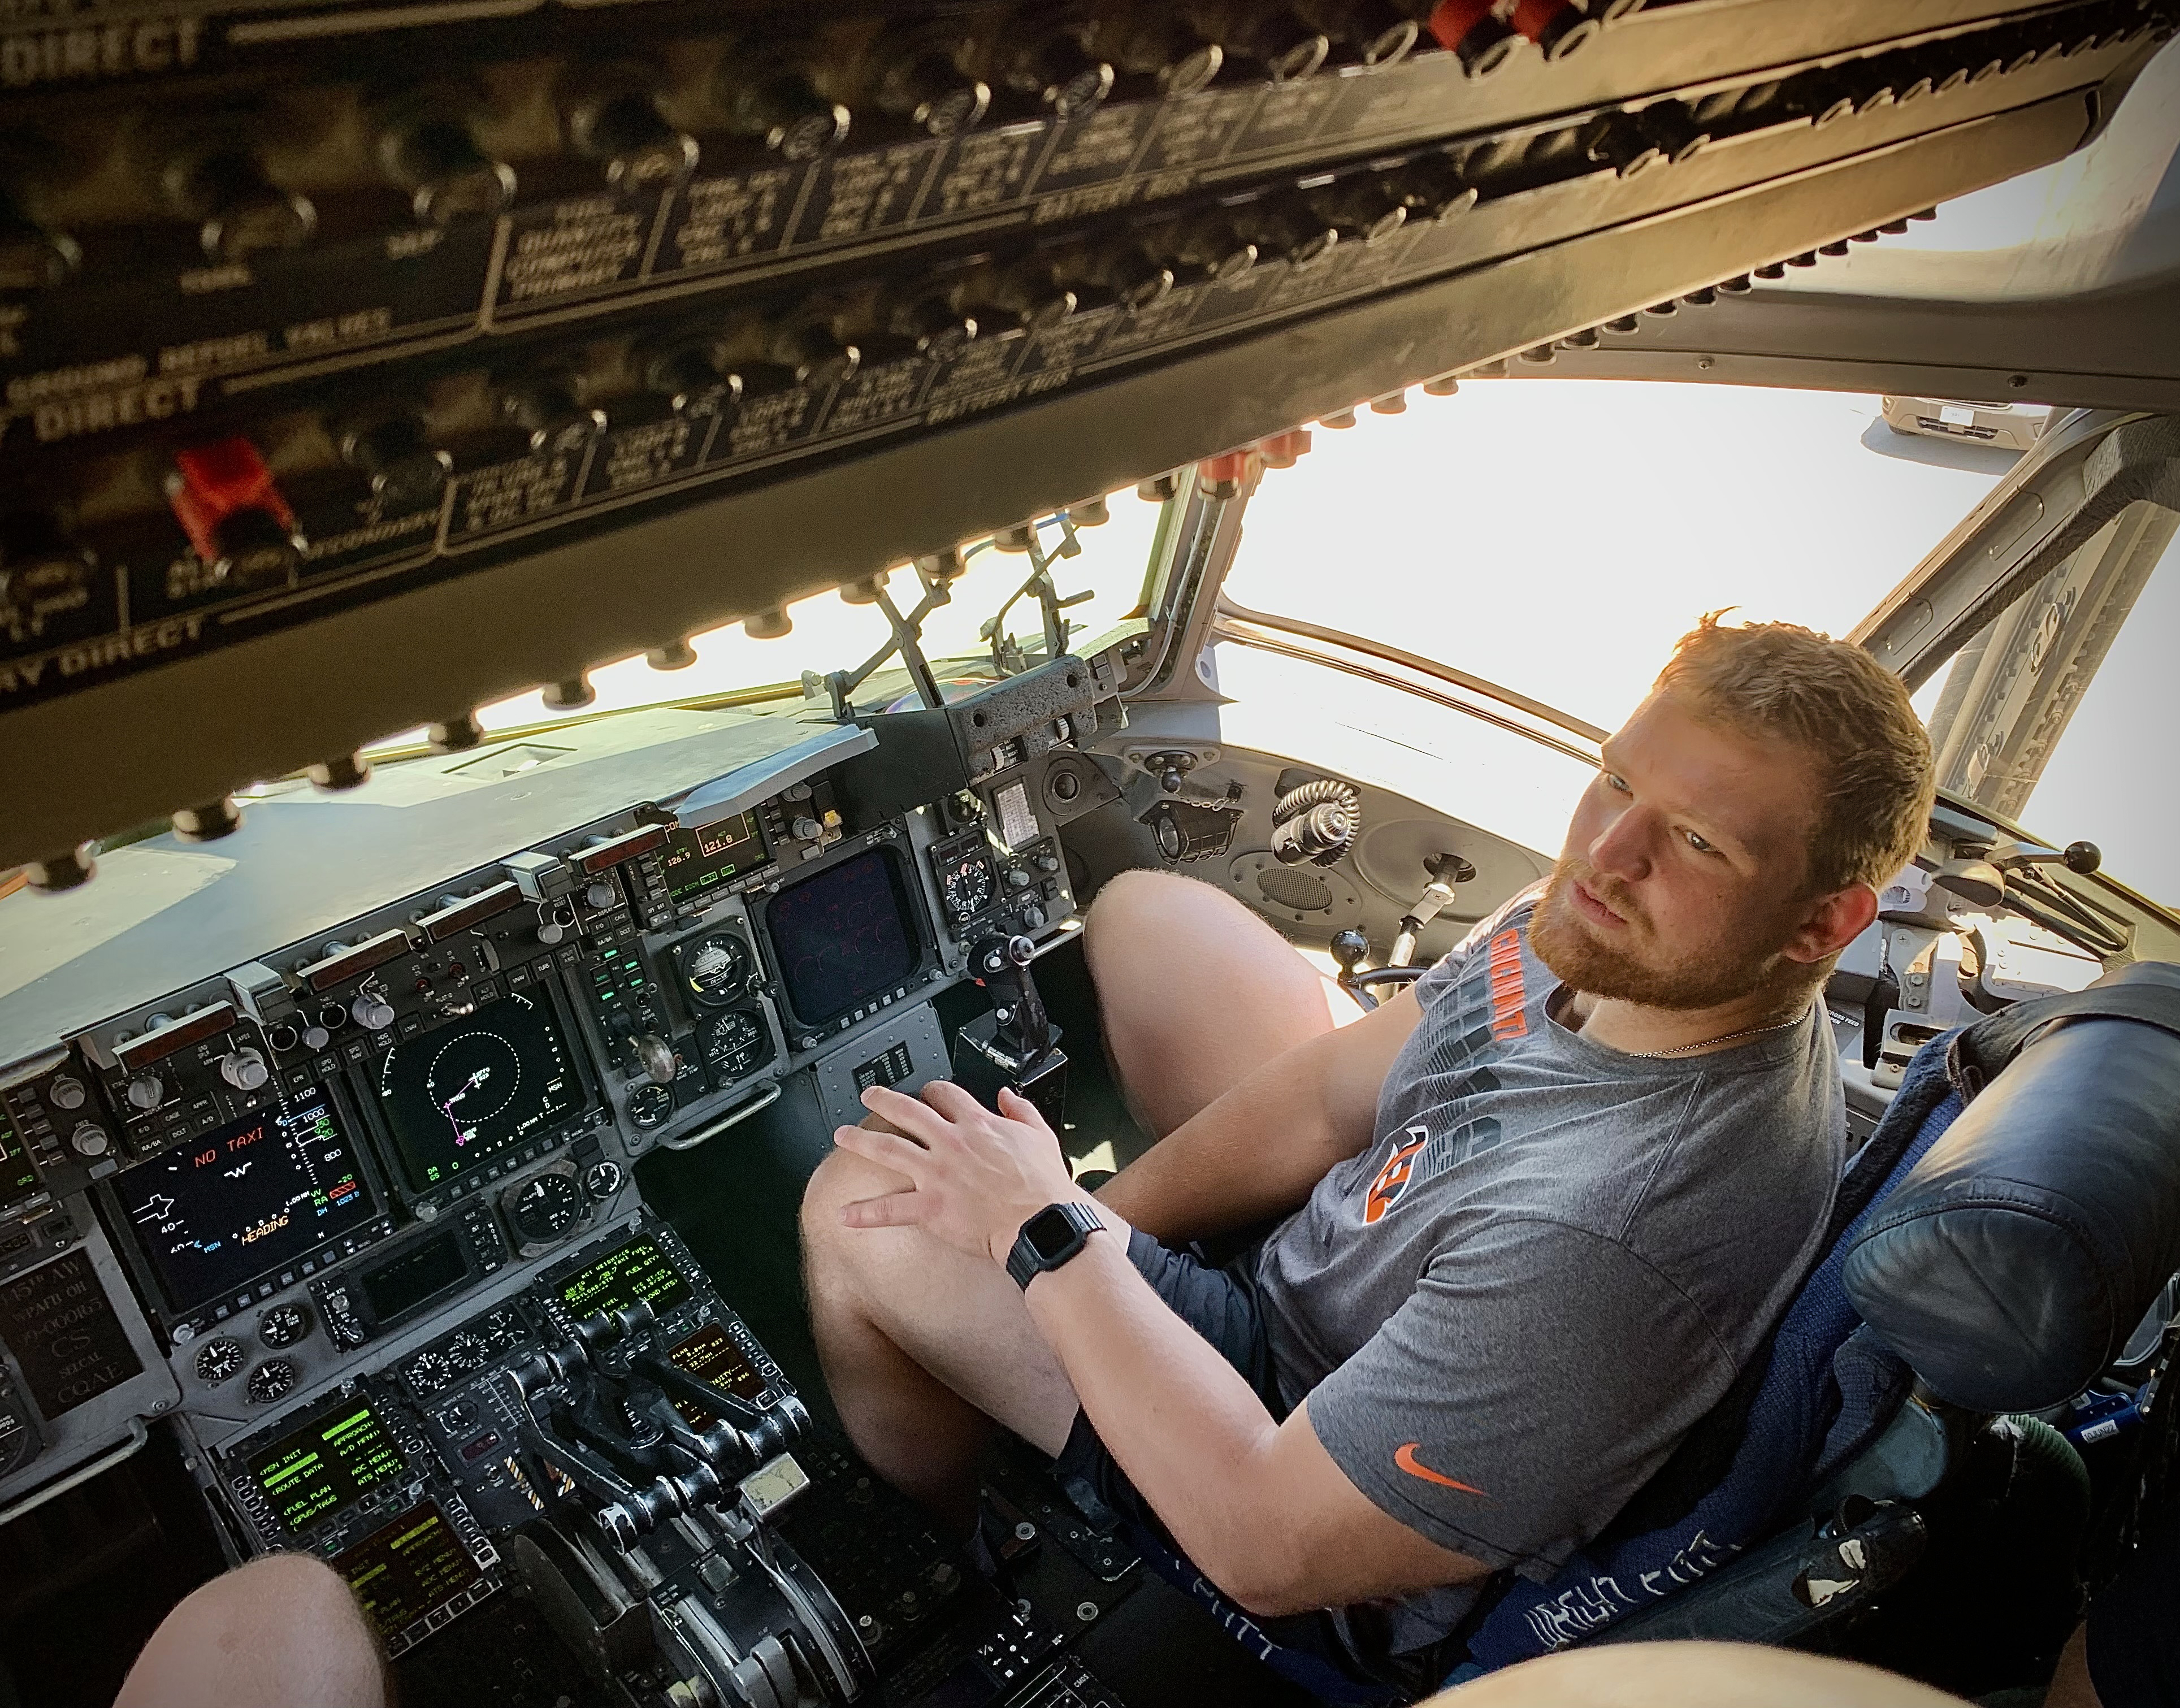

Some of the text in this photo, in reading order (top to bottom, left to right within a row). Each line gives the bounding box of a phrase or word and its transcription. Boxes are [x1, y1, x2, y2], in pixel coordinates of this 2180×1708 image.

[34, 374, 199, 442] DIRECT
[59, 613, 205, 677] DIRECT
[704, 834, 733, 853] 121.8
[668, 851, 691, 866] 126.9
[1490, 929, 1528, 1042] CINCINNTI
[294, 1087, 316, 1102] 1100
[303, 1108, 324, 1122] 1000
[195, 1126, 263, 1167] NO TAXI
[324, 1149, 341, 1161] 800
[314, 1196, 328, 1207] RA
[162, 1223, 175, 1234] 40
[242, 1215, 289, 1246] HEADING
[282, 1449, 302, 1463] INIT
[303, 1463, 324, 1478] DATA
[351, 1463, 367, 1476] AOC
[358, 1473, 373, 1486] ATS
[310, 1485, 331, 1500] PLAN
